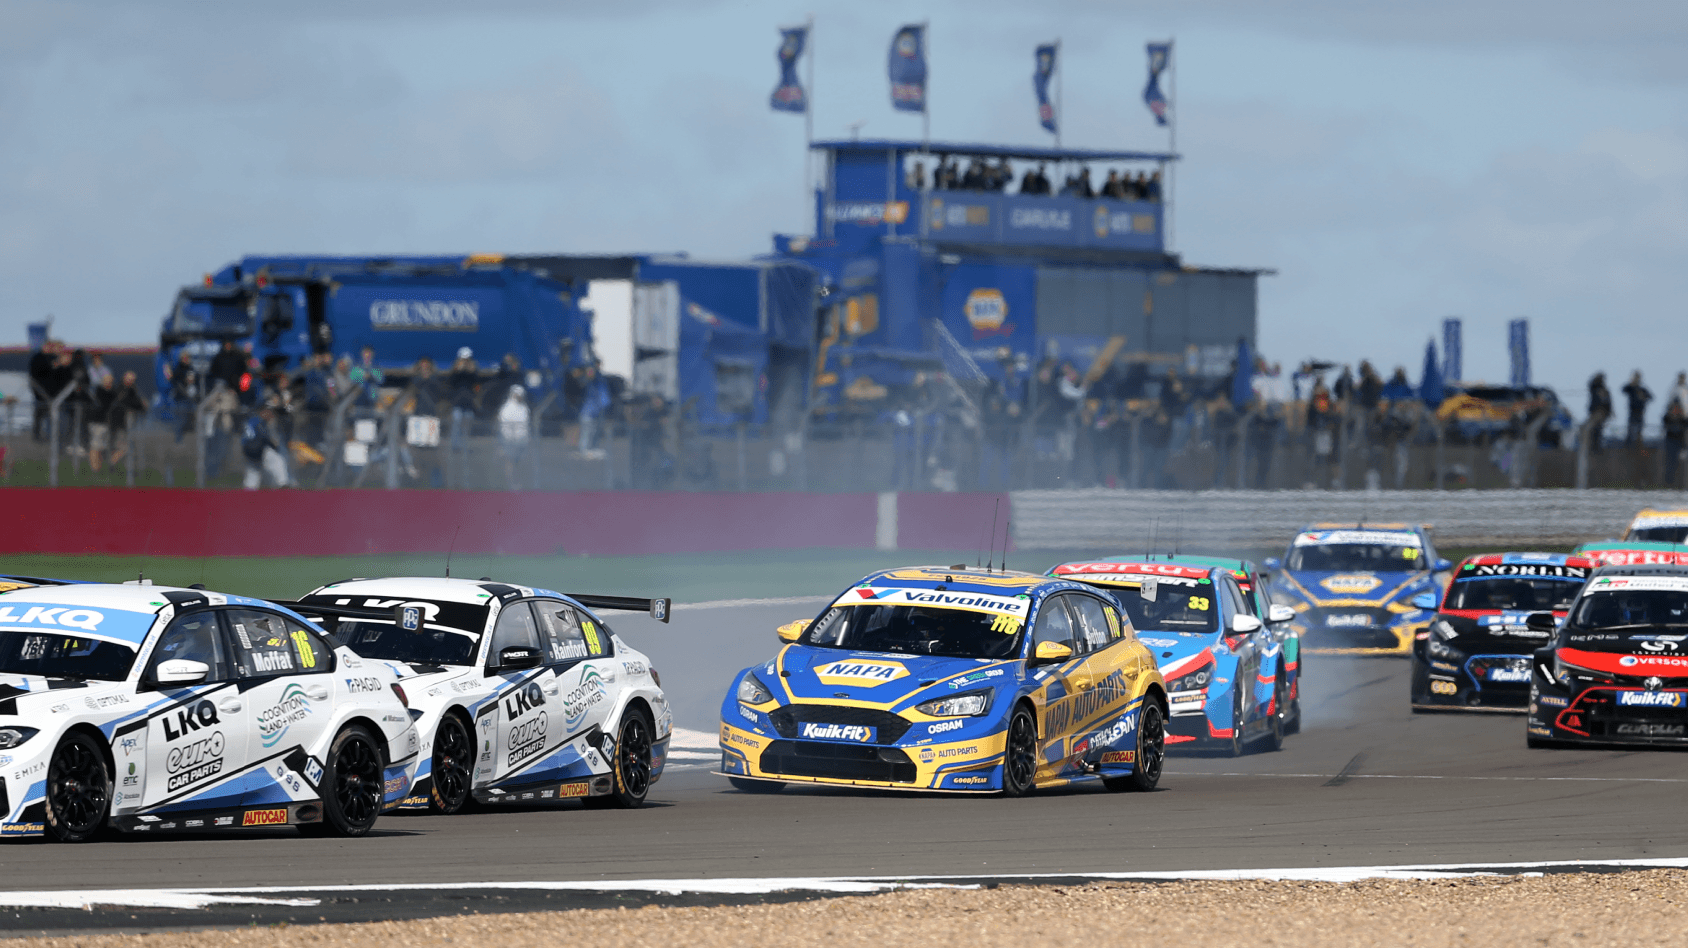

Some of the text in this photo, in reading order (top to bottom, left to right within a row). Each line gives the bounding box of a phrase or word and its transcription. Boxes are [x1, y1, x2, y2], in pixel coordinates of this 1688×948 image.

[370, 300, 479, 324] GRUNDON
[905, 591, 1021, 612] Valvoline
[1188, 595, 1210, 611] 33
[0, 606, 105, 631] LKQ
[990, 614, 1020, 635] 116
[290, 630, 316, 669] 16
[551, 639, 589, 660] Rainford
[251, 650, 294, 672] Moffat
[826, 663, 897, 679] NAPA
[353, 677, 382, 692] PAGID
[567, 677, 599, 705] COGNITION
[262, 696, 304, 721] COGNITION
[505, 682, 546, 721] LKQ
[570, 701, 584, 718] LAND
[587, 690, 604, 708] WATER
[1620, 691, 1675, 705] KwikFit
[162, 699, 221, 742] LKQ
[265, 719, 282, 734] LAND
[287, 709, 307, 726] WATER
[508, 710, 549, 750] euro
[928, 719, 963, 734] OSRAM
[803, 723, 864, 740] KwikFit
[166, 730, 226, 774] euro
[509, 739, 546, 765] CAR PARTS
[744, 738, 760, 748] PARTS
[938, 749, 956, 758] AUTO
[957, 746, 978, 755] PARTS
[1102, 751, 1134, 762] AUTOCAR
[14, 761, 46, 780] EMIXA
[169, 760, 222, 789] CAR PARTS
[953, 776, 987, 784] GOODYEAR
[560, 783, 588, 797] AUTOCAR
[244, 810, 286, 824] AUTOCAR
[2, 823, 45, 833] GOODYEAR
